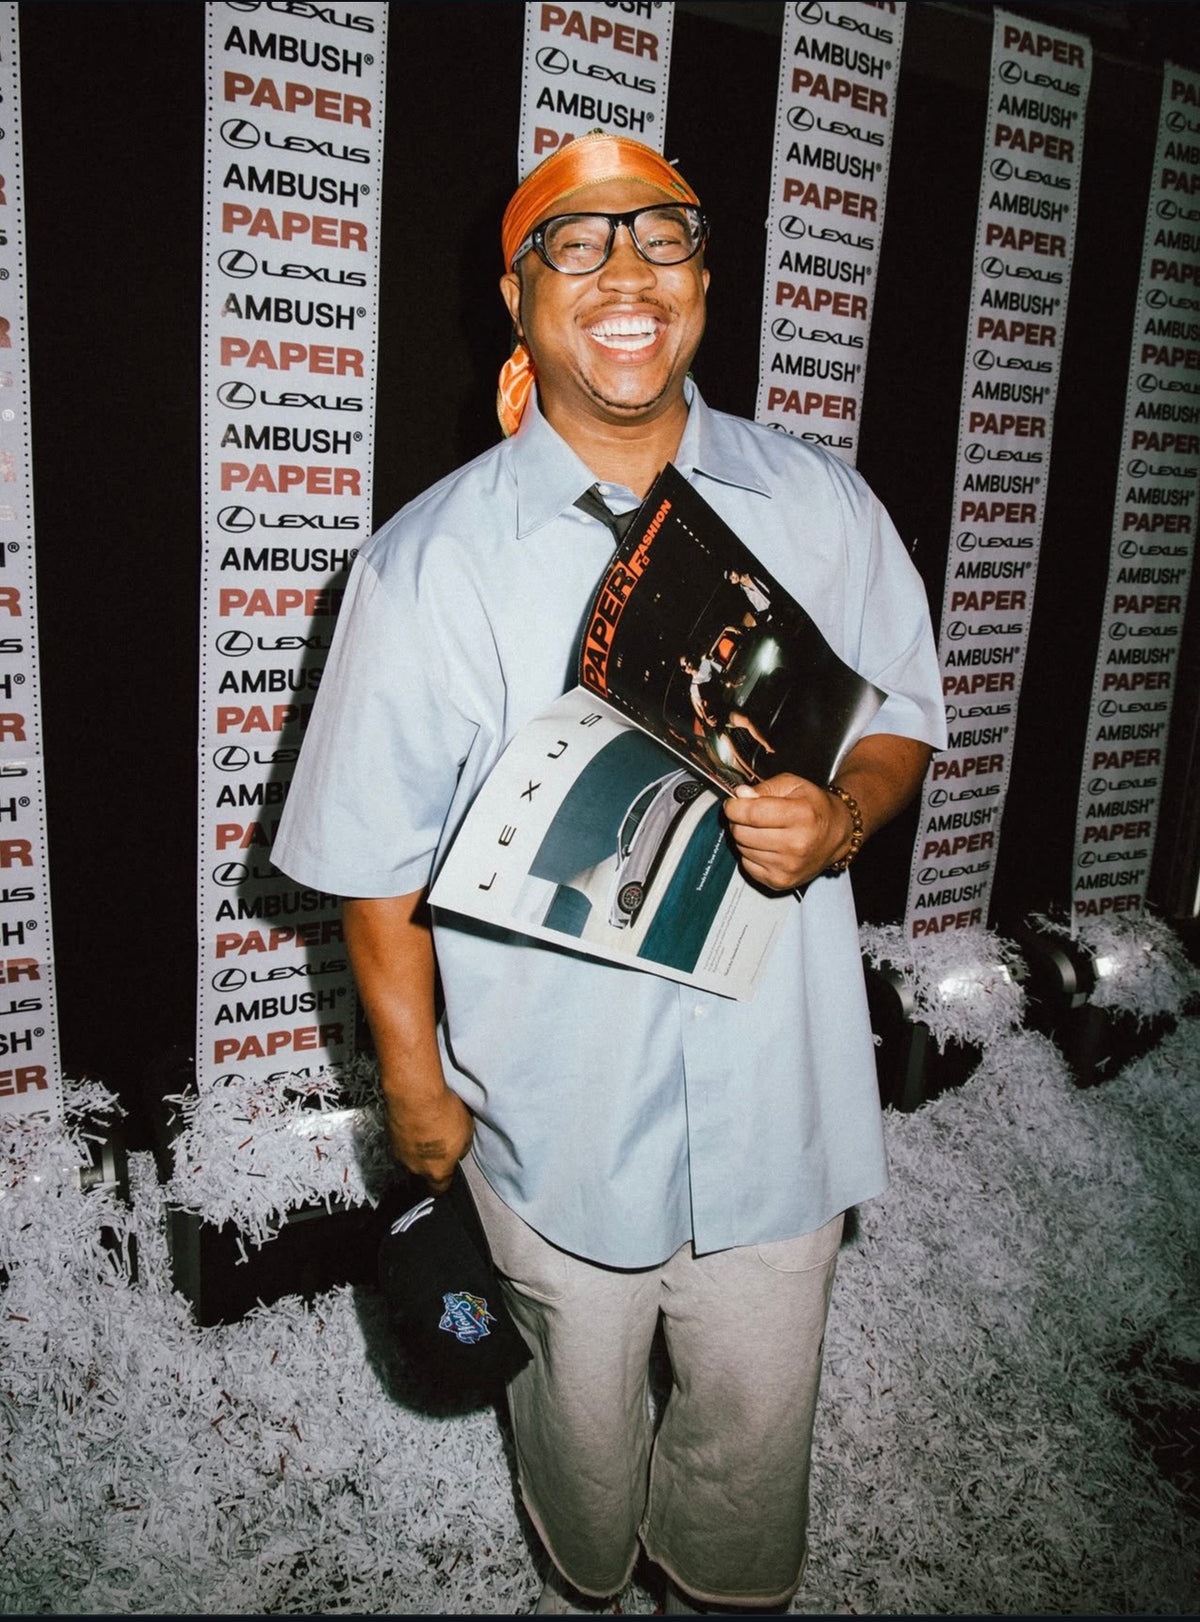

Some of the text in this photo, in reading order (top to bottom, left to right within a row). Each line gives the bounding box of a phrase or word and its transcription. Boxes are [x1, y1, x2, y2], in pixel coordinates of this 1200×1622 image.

[266, 2, 374, 32] LEXUS
[825, 11, 893, 45] LEXUS
[540, 3, 659, 62] PAPER
[1003, 25, 1085, 69] PAPER
[224, 25, 374, 78] AMBUSH®
[794, 35, 892, 80] AMBUSH®
[572, 59, 656, 94] LEXUS
[1023, 70, 1081, 97] LEXUS
[224, 71, 371, 128] PAPER
[791, 67, 888, 118] PAPER
[536, 87, 654, 133] AMBUSH®
[816, 117, 884, 147] LEXUS
[994, 123, 1075, 164] PAPER
[265, 131, 371, 164] LEXUS
[786, 142, 882, 182] AMBUSH®
[223, 163, 370, 208] AMBUSH®
[1014, 167, 1071, 190] LEXUS
[783, 178, 878, 222] PAPER
[222, 203, 367, 252] PAPER
[808, 225, 874, 251] LEXUS
[985, 223, 1066, 258] PAPER
[262, 260, 367, 287] LEXUS
[779, 250, 872, 286] AMBUSH®
[1005, 264, 1063, 285] LEXUS
[221, 293, 366, 329] AMBUSH®
[775, 281, 868, 321] PAPER
[798, 327, 864, 349] LEXUS
[977, 316, 1057, 348] PAPER
[221, 337, 364, 377] PAPER
[771, 352, 861, 384] AMBUSH®
[996, 356, 1053, 373] LEXUS
[1141, 343, 1200, 371] PAPE
[260, 390, 363, 412] LEXUS
[767, 387, 857, 421] PAPER
[221, 424, 363, 455] AMBUSH®
[790, 431, 853, 449] EXUS
[969, 411, 1046, 439] PAPER
[987, 449, 1043, 463] LEXUS
[221, 462, 361, 496] PAPER
[260, 513, 360, 530] LEXUS
[960, 501, 1037, 524] PAPER
[1122, 512, 1192, 534] PAPER
[978, 537, 1034, 548] LEXUS
[951, 590, 1027, 612] PAPER
[1112, 594, 1182, 614] PAPER
[257, 636, 333, 650] LEXU
[583, 560, 638, 697] PAPER
[968, 623, 1023, 636] LEXUS
[219, 669, 322, 694] AMBUS
[942, 672, 1016, 697] PAPER
[1102, 671, 1172, 692] PAPER
[217, 705, 308, 734] PAP
[958, 704, 1011, 719] LEXUS
[947, 726, 1009, 750] MBUSH®
[932, 753, 1004, 781] PAPER
[1092, 748, 1162, 771] PAPER
[949, 784, 1000, 802] LEXUS
[922, 830, 995, 860] PAPER
[1082, 820, 1152, 844] PAPER
[939, 860, 991, 879] LEXUS
[912, 907, 982, 939] PAPER
[215, 920, 344, 958] PAPER
[250, 960, 347, 983] LEXUS
[214, 987, 346, 1025] AMBUSH®
[213, 1023, 343, 1064] PAPER
